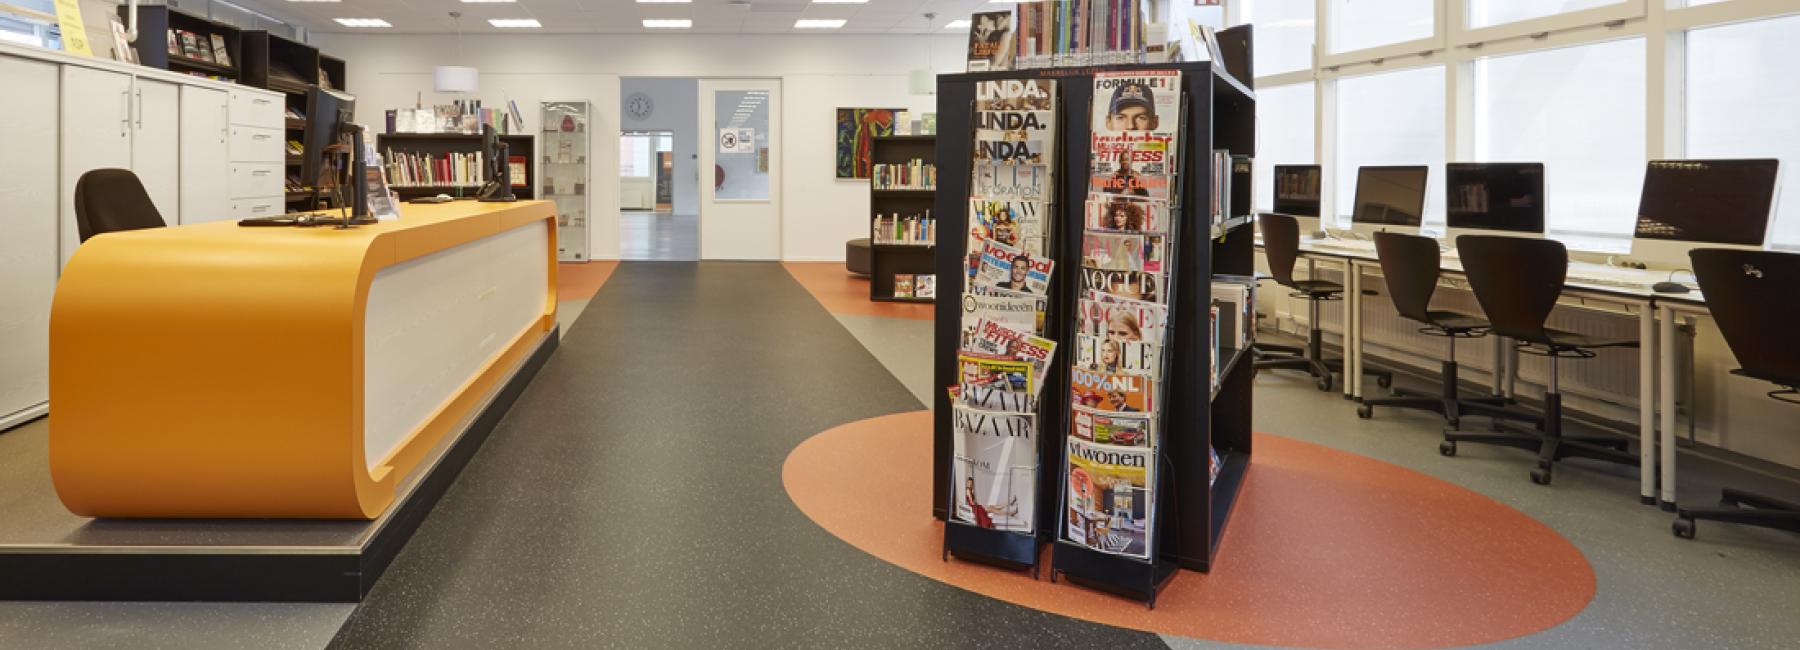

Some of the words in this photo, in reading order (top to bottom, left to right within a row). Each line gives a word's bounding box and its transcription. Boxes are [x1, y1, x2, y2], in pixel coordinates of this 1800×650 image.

[976, 79, 1048, 100] LINDA.
[1160, 79, 1166, 88] 1
[972, 111, 1046, 130] LINDA.
[1099, 150, 1163, 162] FITESS
[955, 408, 1029, 439] BAZAAR
[1069, 442, 1145, 468] vtwonen
